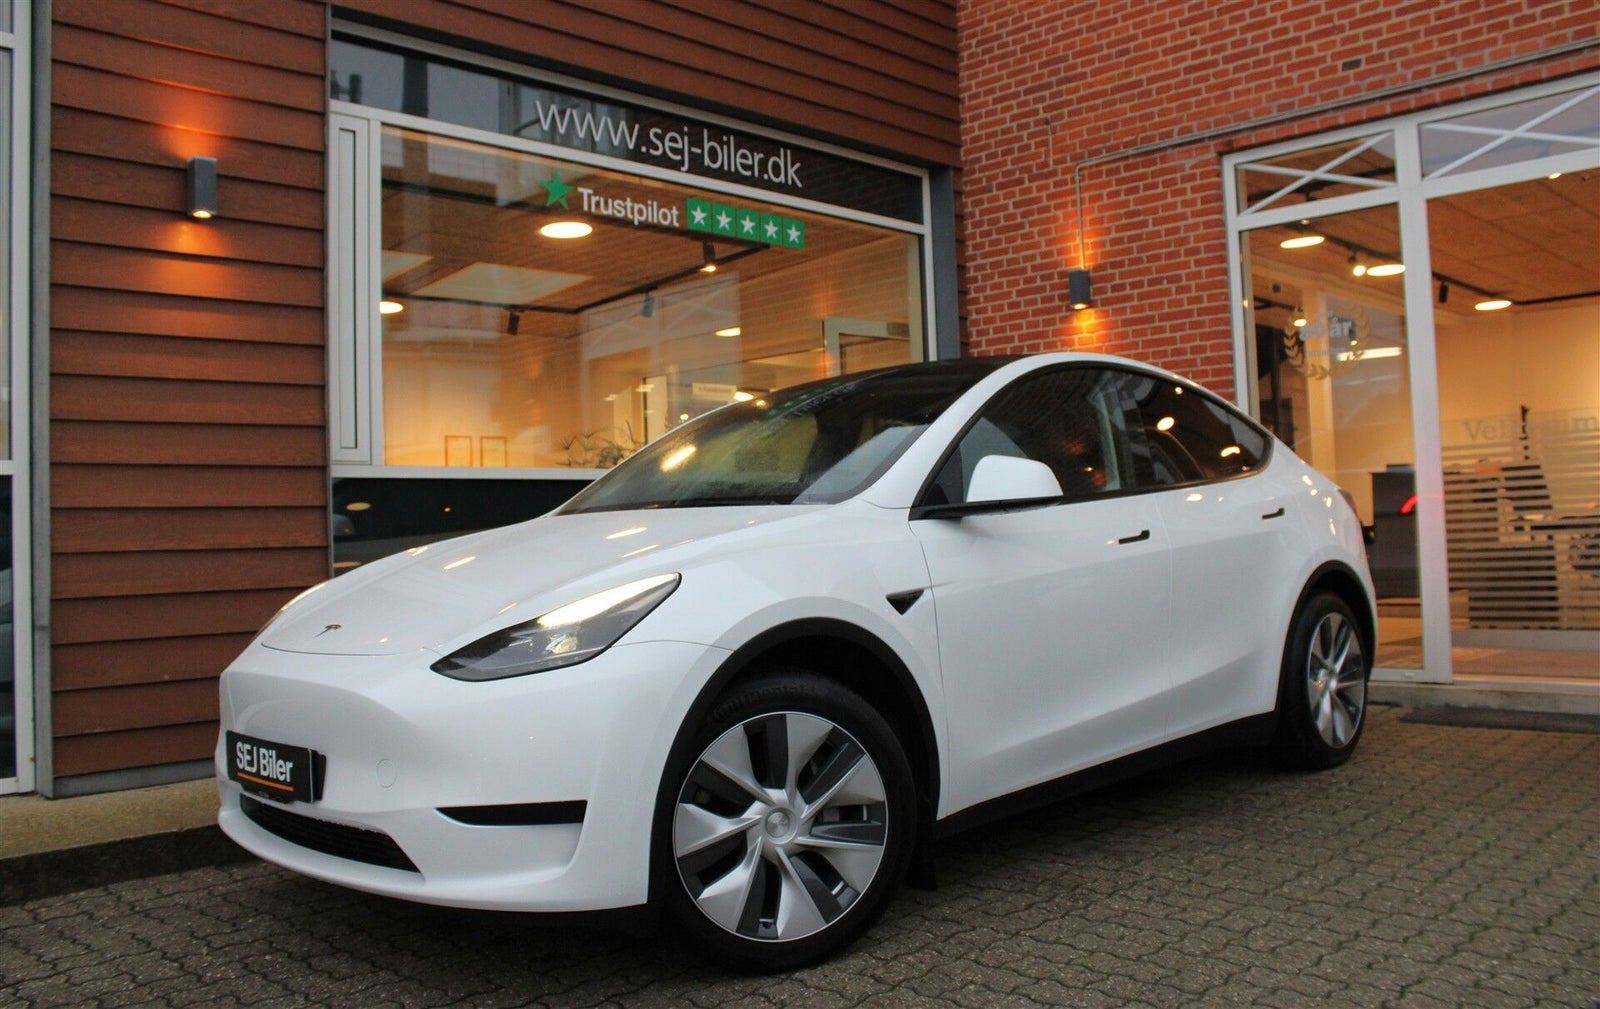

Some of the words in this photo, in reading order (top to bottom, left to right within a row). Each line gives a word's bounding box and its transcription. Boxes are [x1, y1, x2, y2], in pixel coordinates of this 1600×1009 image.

[535, 100, 803, 188] www.sej-biler.dk
[577, 187, 680, 228] Trustpilot
[235, 741, 258, 774] SEJ
[259, 747, 294, 783] Biler
